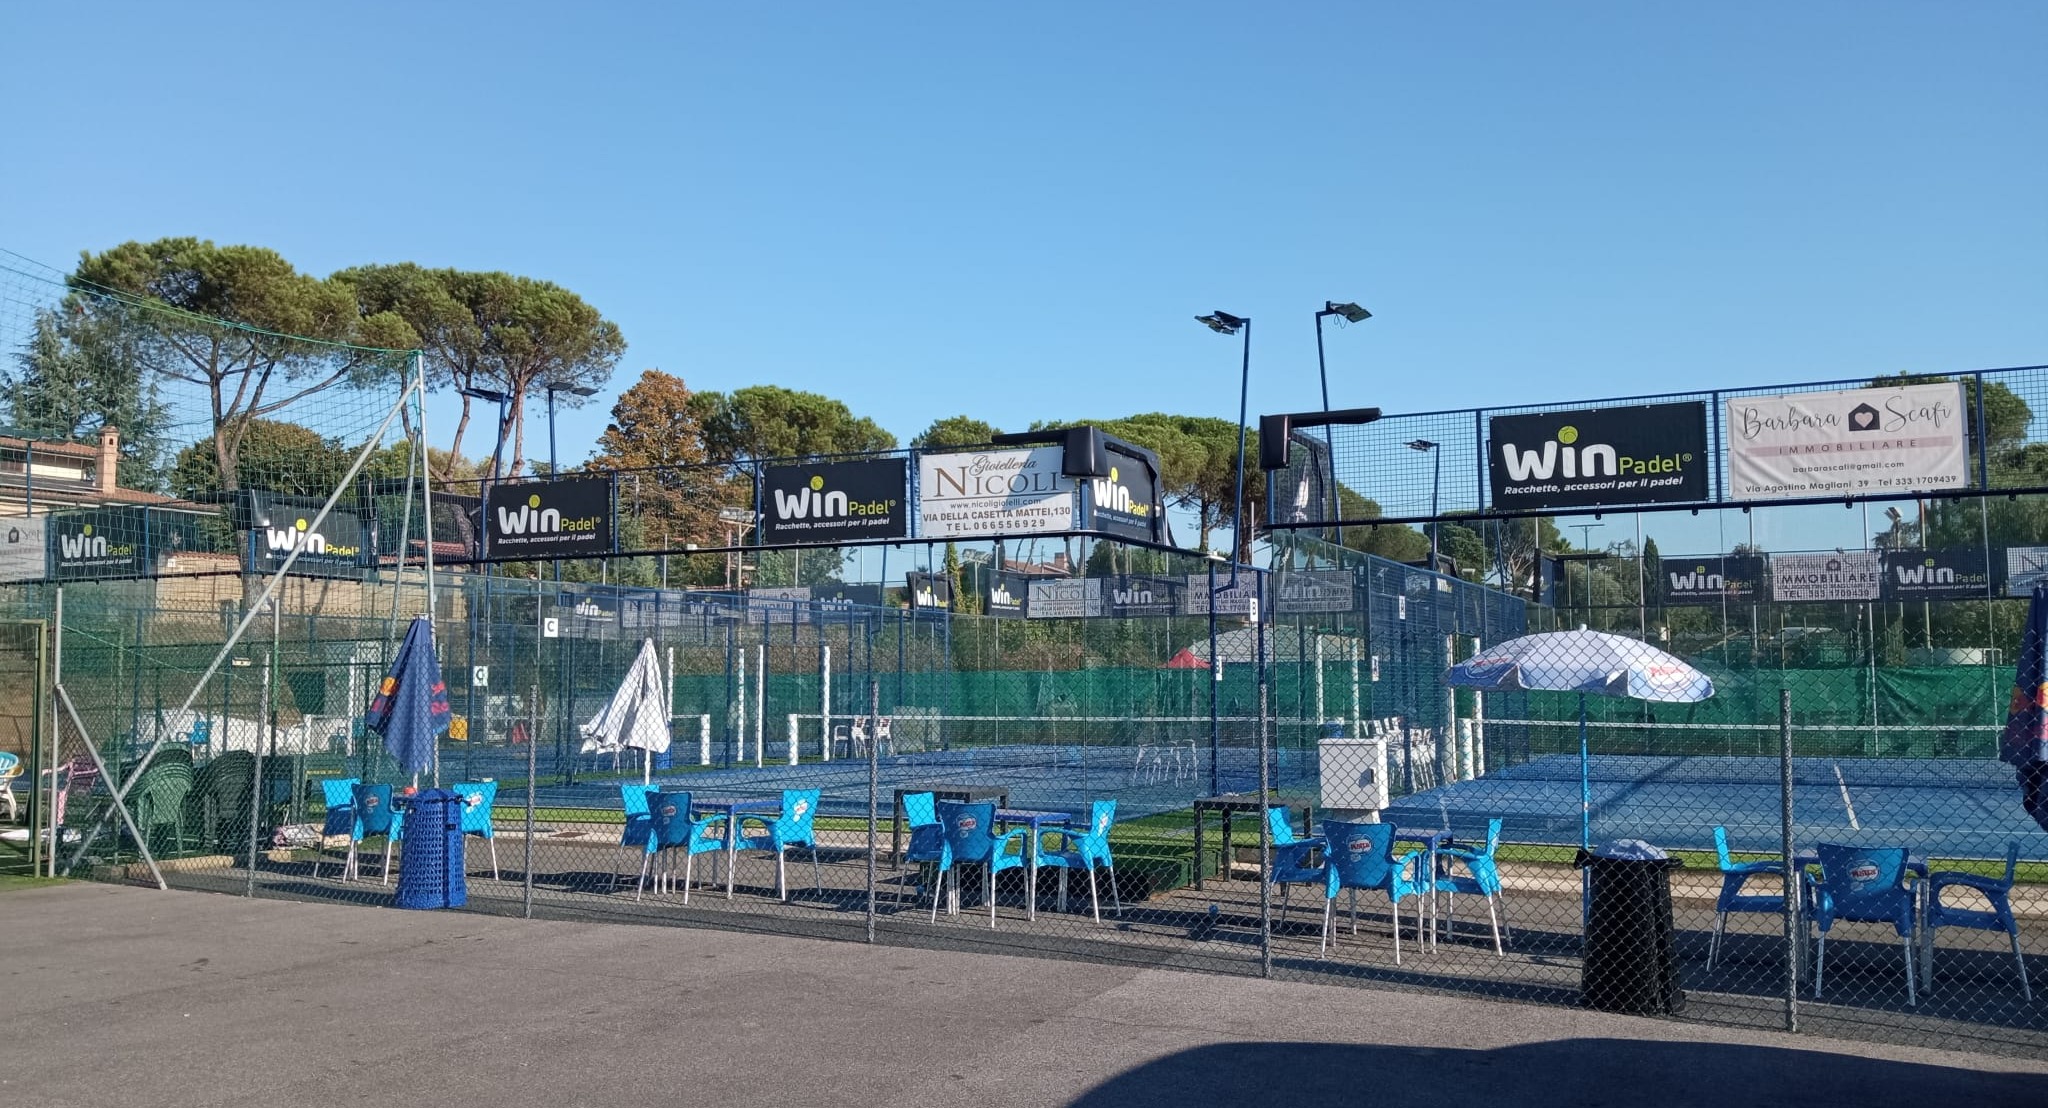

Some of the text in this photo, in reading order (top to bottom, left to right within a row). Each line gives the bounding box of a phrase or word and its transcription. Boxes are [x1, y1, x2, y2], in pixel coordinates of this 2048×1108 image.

[1743, 396, 1951, 440] Barbara Scafi
[1779, 438, 1918, 455] IMMOBILIARE
[969, 454, 1037, 477] Gioielleria
[1504, 476, 1684, 495] Racchette, accessori per il padel
[1745, 485, 1761, 493] Via
[1764, 484, 1806, 493] Agostino
[1895, 478, 1912, 486] 333
[1917, 475, 1957, 484] 1709439
[950, 498, 1041, 510] www.nicoligioielli.com
[923, 513, 938, 522] VIA
[940, 511, 969, 521] DELLA
[971, 509, 1013, 520] CASETTA
[774, 522, 812, 531] Racchette,
[813, 519, 847, 528] accessori
[847, 519, 861, 528] per
[868, 517, 890, 527] padel
[1776, 572, 1877, 584] IMMOBILIARE
[546, 620, 555, 633] C
